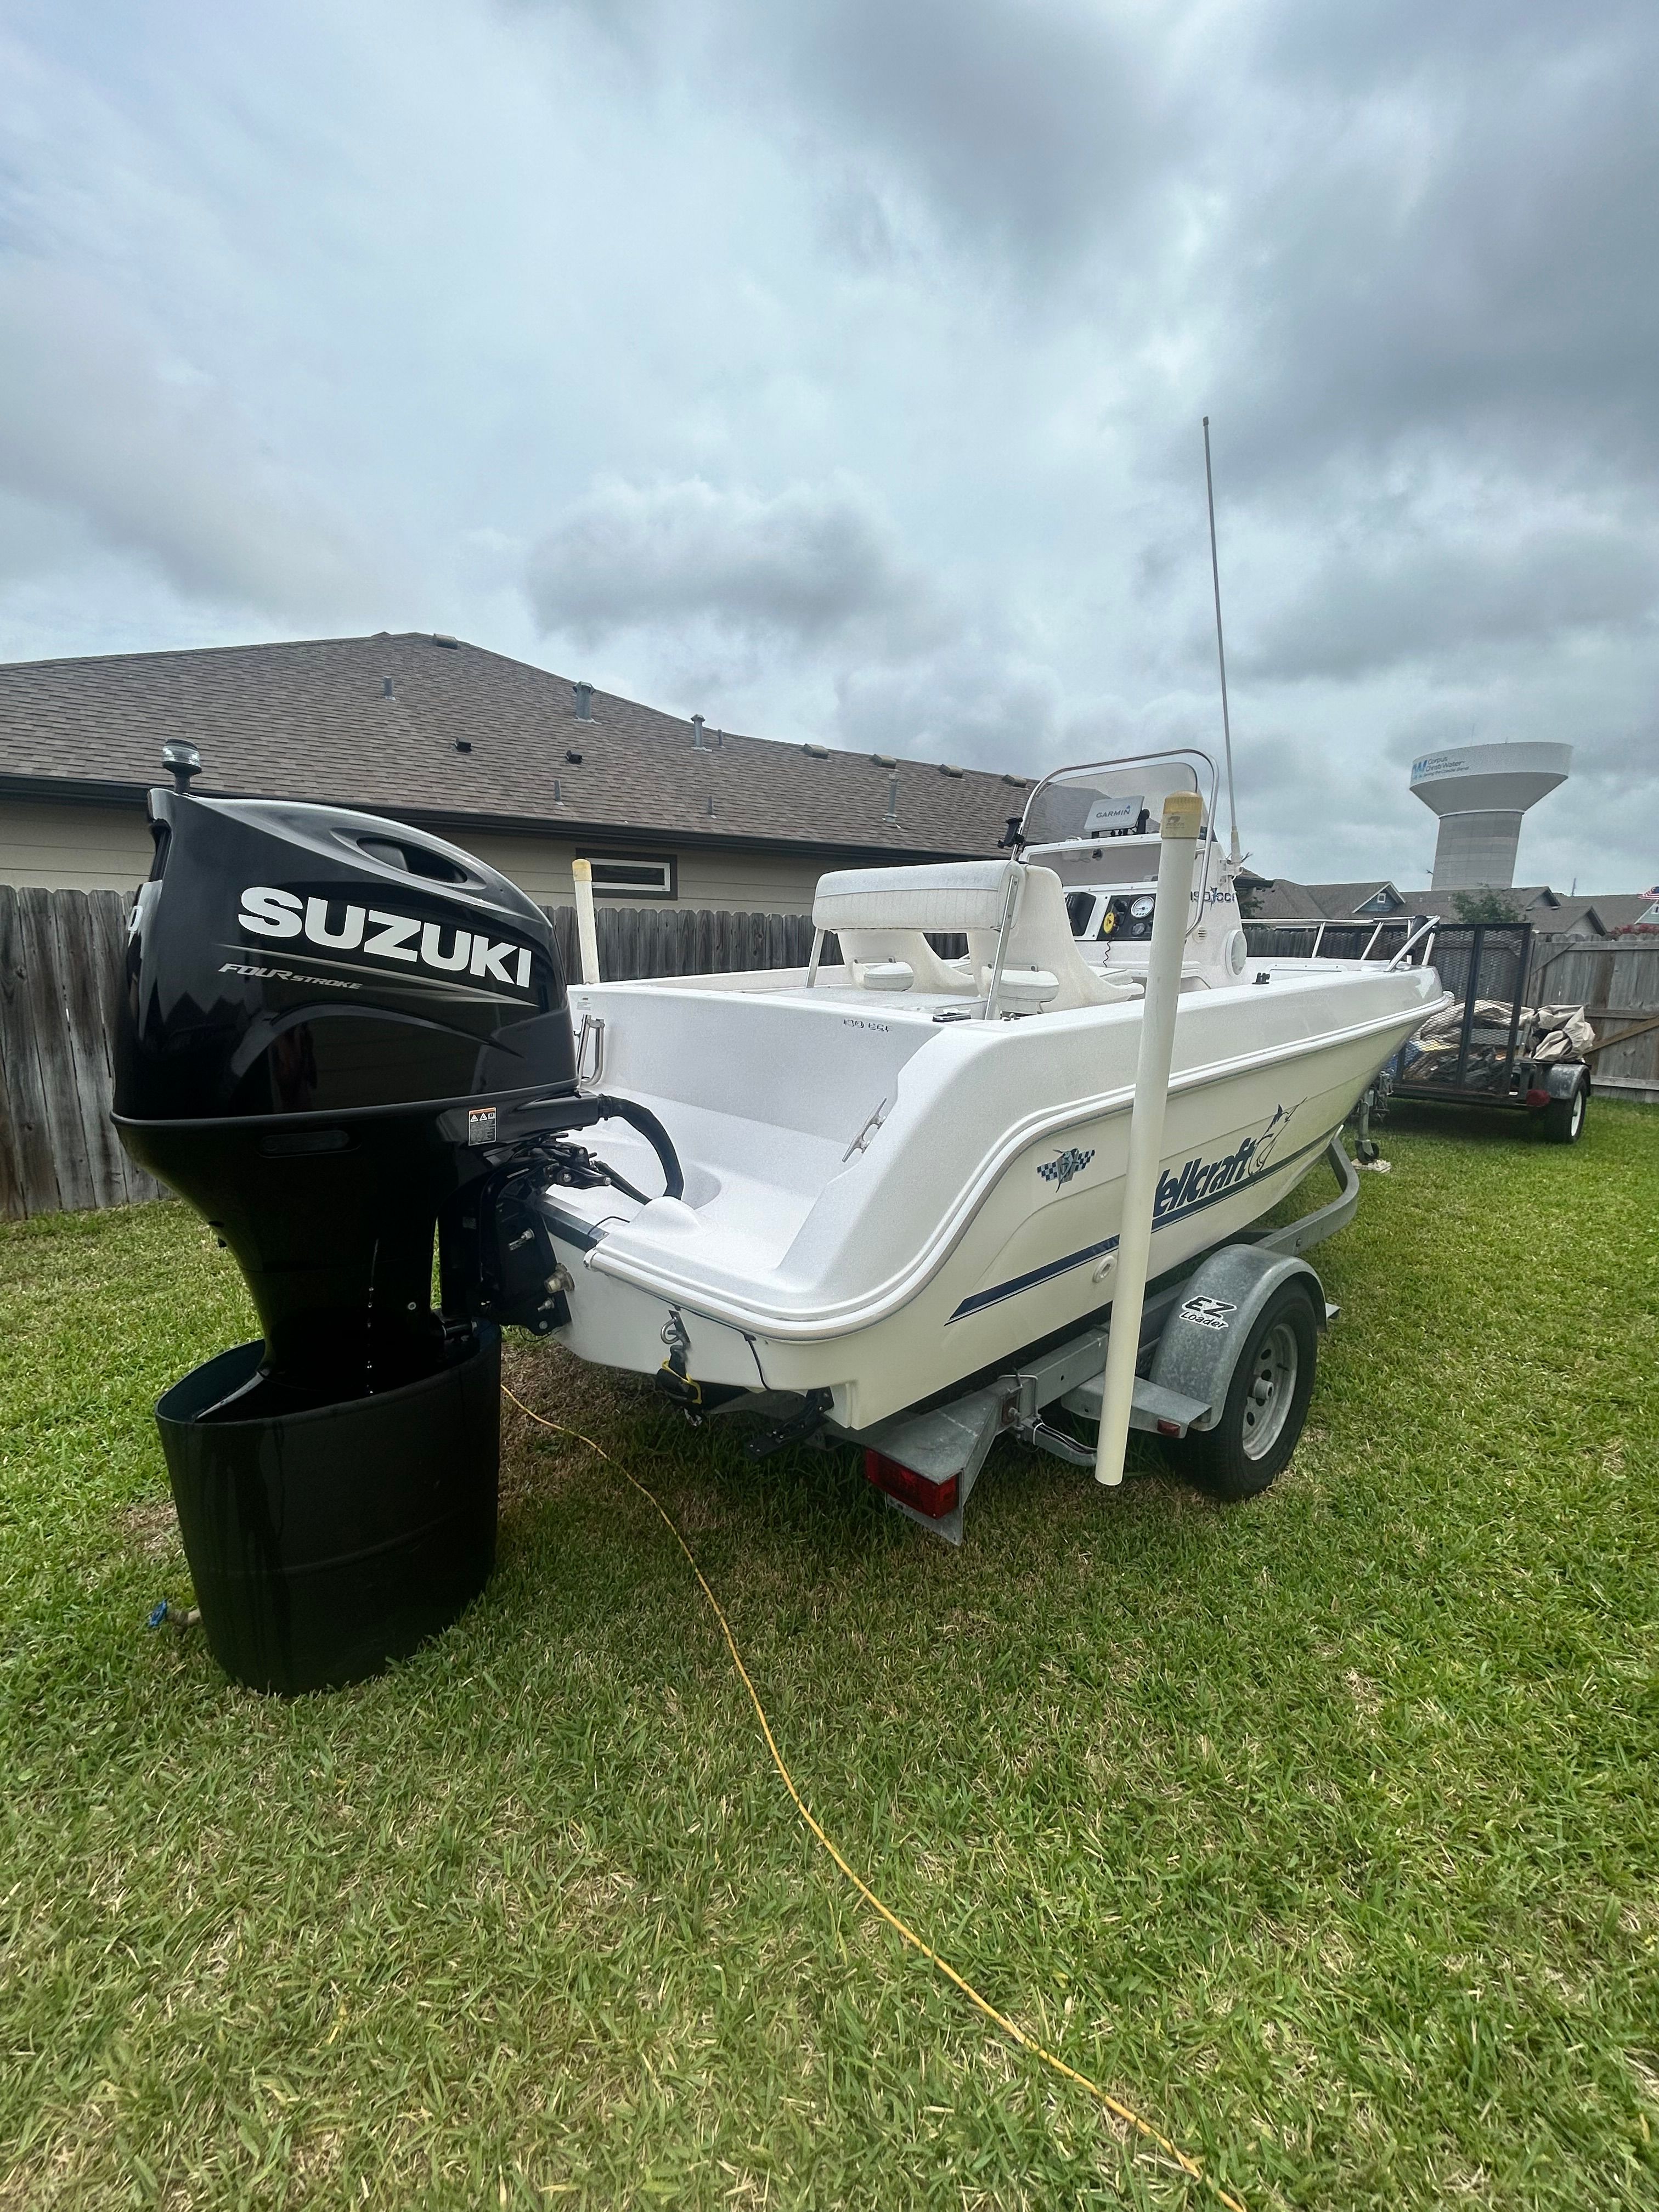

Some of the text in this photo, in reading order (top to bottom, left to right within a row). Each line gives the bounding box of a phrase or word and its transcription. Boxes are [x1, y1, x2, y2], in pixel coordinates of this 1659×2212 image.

[1096, 809, 1131, 819] GARMIN
[238, 886, 532, 988] SUZUKI
[218, 963, 363, 990] FOUR STROKE
[1185, 1296, 1235, 1318] EZ
[1181, 1311, 1227, 1328] Loader
